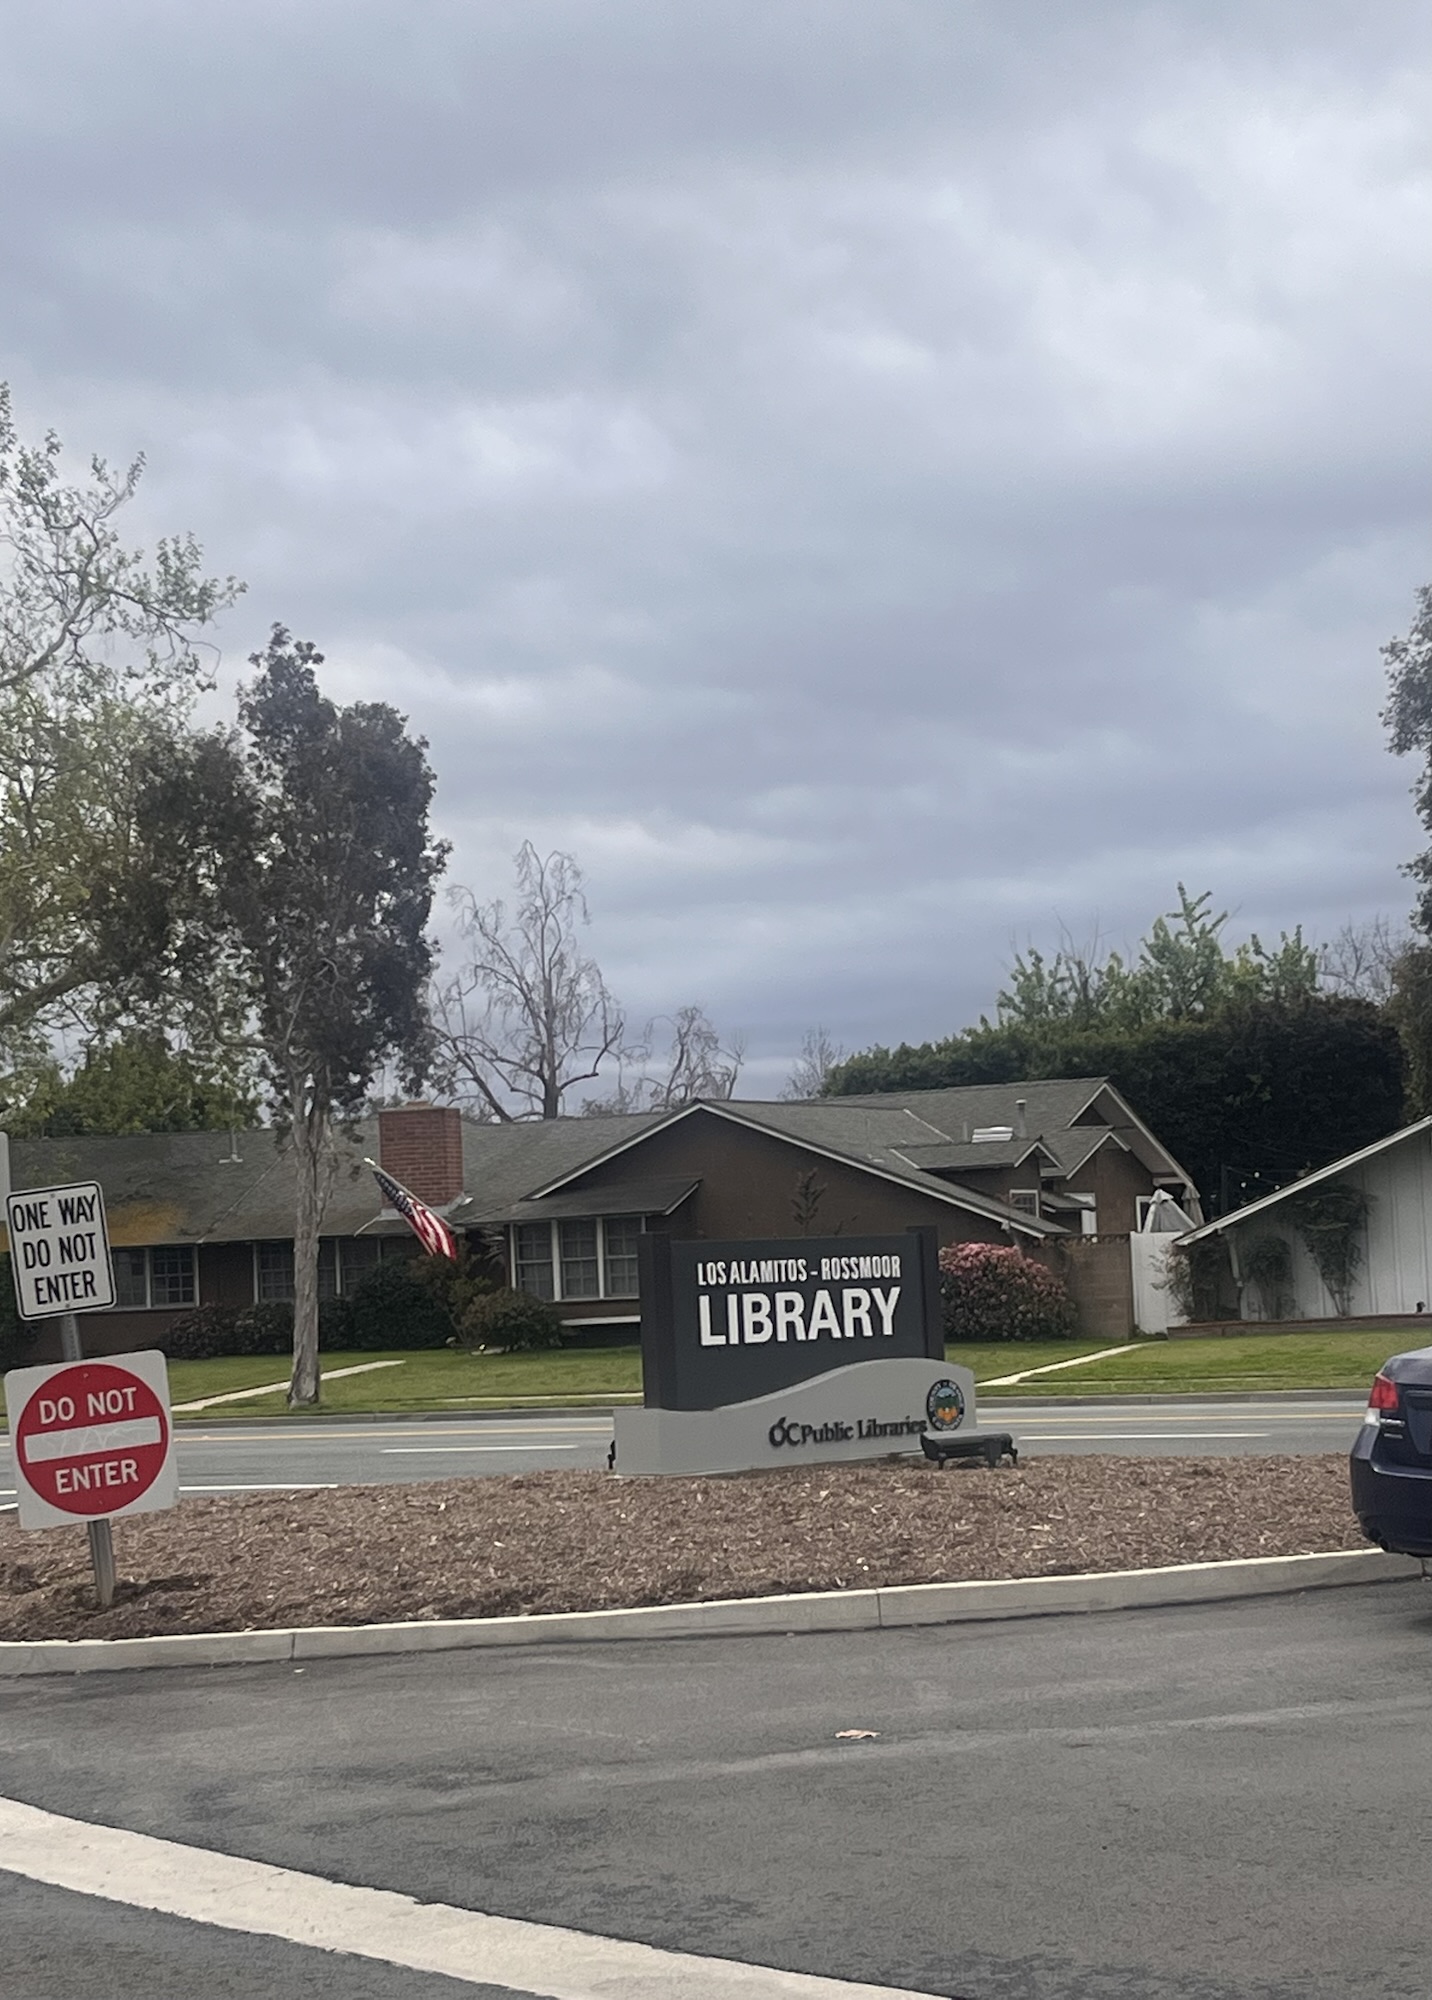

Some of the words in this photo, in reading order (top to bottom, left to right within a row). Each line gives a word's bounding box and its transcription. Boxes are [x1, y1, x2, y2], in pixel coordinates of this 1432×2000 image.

[12, 1201, 52, 1232] ONE
[58, 1193, 96, 1226] WAY
[22, 1238, 51, 1270] DO
[58, 1232, 96, 1265] NOT
[34, 1270, 97, 1305] ENTER
[697, 1261, 726, 1286] LOS
[729, 1259, 807, 1285] ALAMITOS
[821, 1255, 901, 1281] ROSSMOOR
[699, 1286, 901, 1346] LIBRARY
[39, 1396, 75, 1425] DO
[87, 1386, 137, 1418] NOT
[857, 1415, 928, 1440] Libraries
[55, 1458, 139, 1494] ENTER
